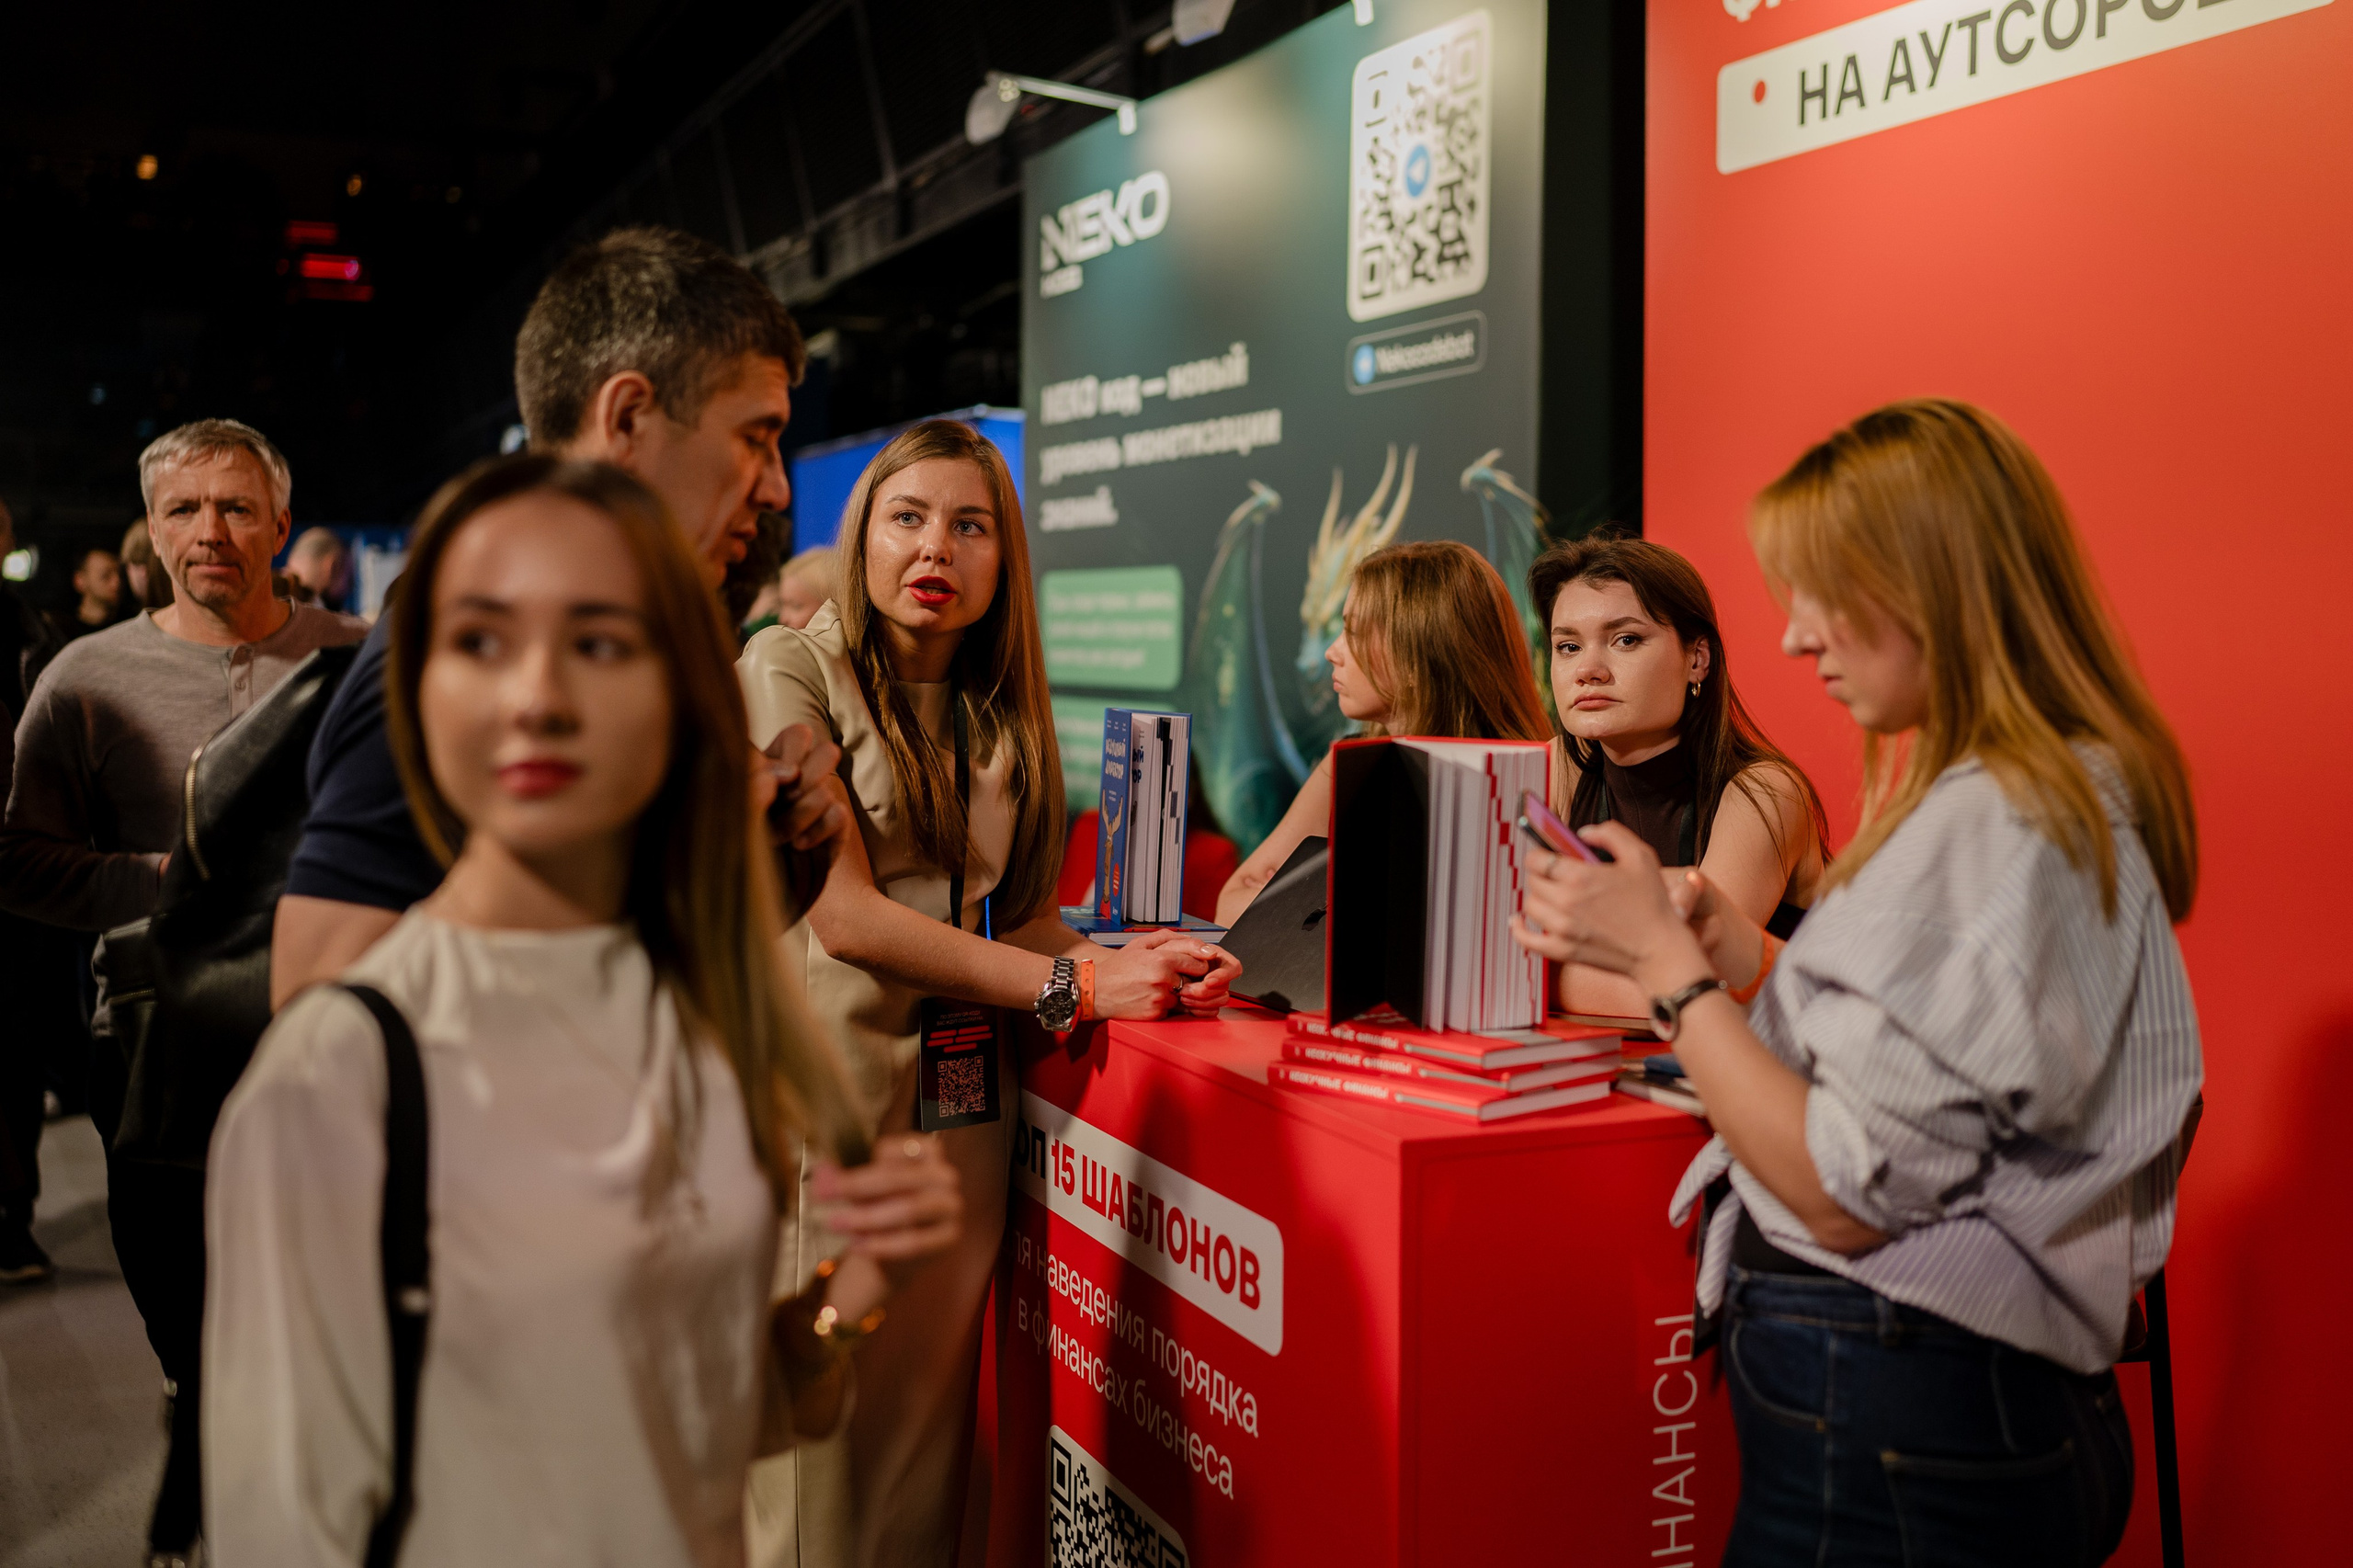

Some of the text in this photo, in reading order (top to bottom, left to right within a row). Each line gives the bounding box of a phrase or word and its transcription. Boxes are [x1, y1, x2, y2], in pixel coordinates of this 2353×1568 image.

[1797, 0, 2232, 127] НА АУТСОР
[1040, 169, 1170, 272] NEKO
[1166, 341, 1249, 401] новый
[1289, 1070, 1342, 1089] НЕСКУЧНЫЕ
[1304, 1047, 1361, 1066] НЕСКУЧНЫЕ
[1306, 1023, 1356, 1041] НЕСКЧНЫЕ
[1014, 1117, 1261, 1311] ОП 15 ШАБЛОНОВ
[1015, 1230, 1259, 1438] ля наведения порядка
[1017, 1298, 1234, 1500] в финансах бизнеса
[1651, 1313, 1698, 1568] НАНСЫ
